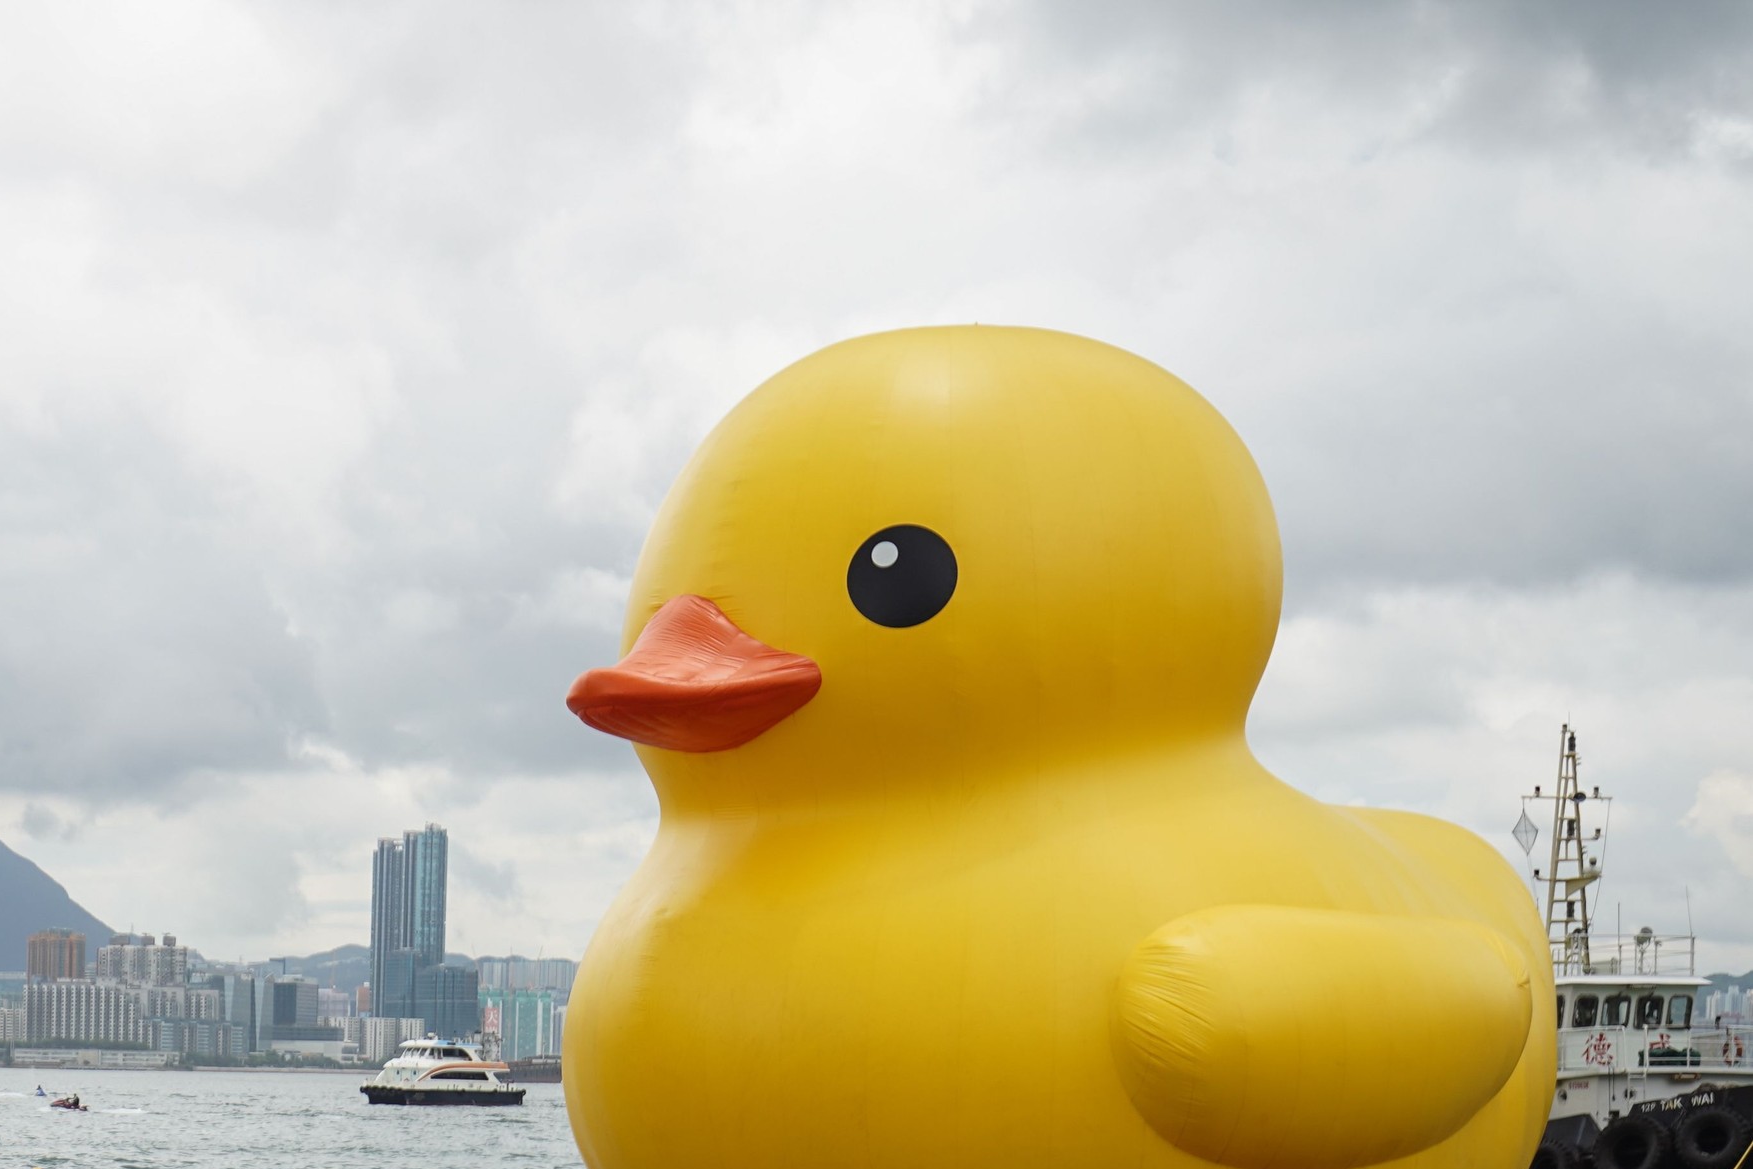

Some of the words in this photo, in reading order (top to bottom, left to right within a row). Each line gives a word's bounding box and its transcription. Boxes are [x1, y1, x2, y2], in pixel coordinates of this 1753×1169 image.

[1582, 1031, 1614, 1066] 德
[1660, 1097, 1683, 1112] TAK
[1691, 1092, 1715, 1107] WAI
